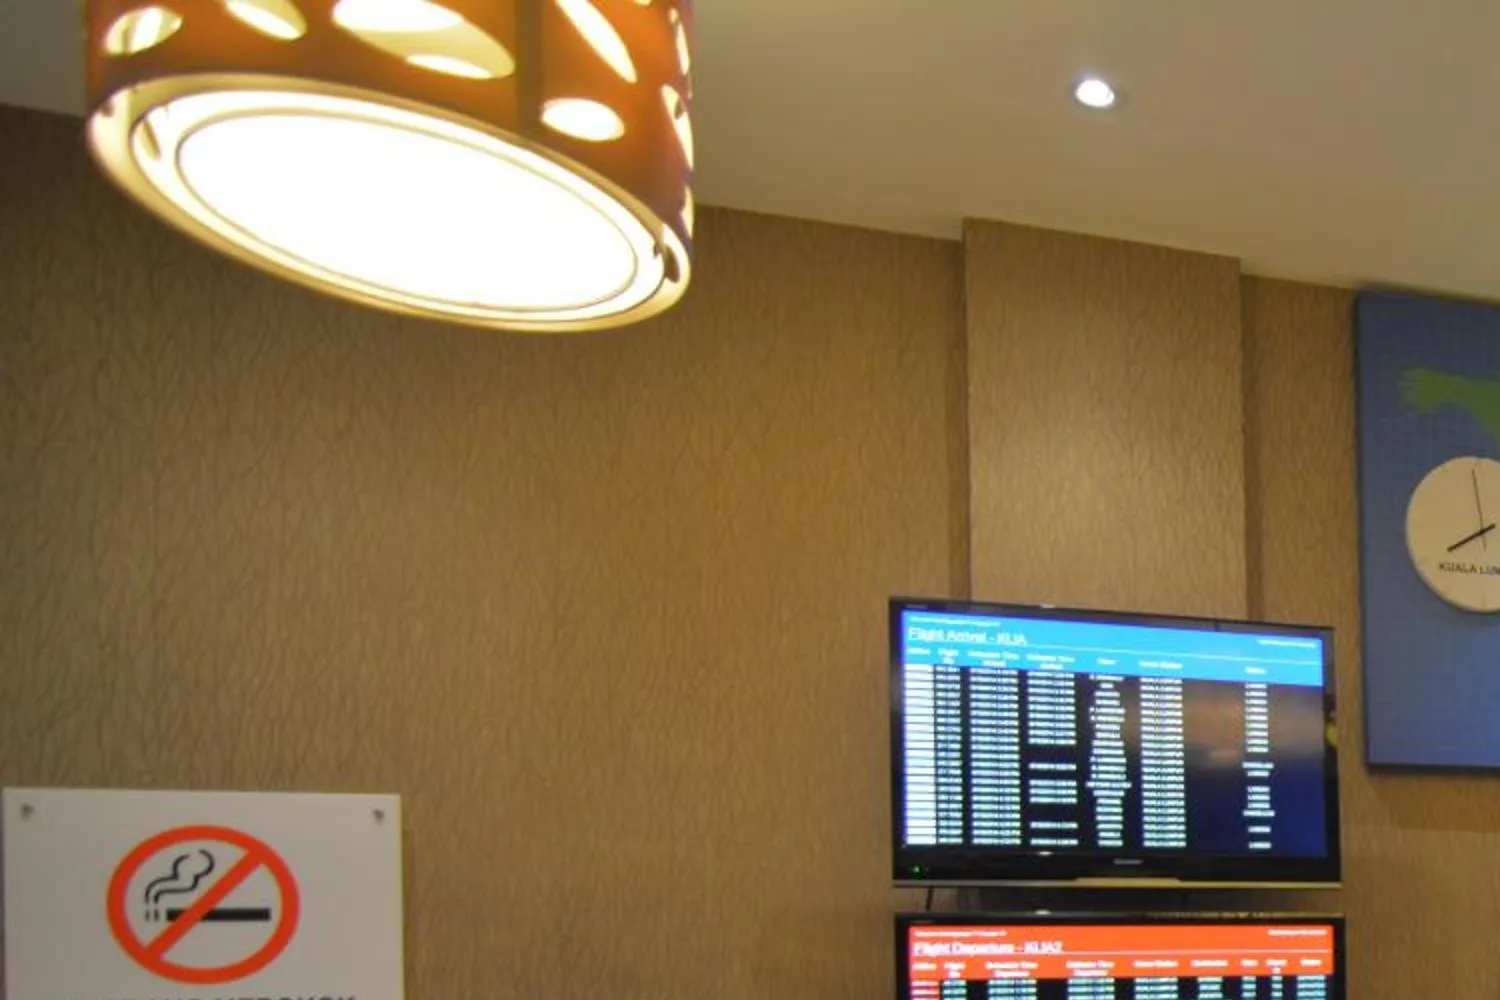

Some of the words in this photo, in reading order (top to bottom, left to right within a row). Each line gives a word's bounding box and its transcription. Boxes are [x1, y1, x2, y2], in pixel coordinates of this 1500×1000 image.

[1438, 562, 1477, 575] KUALA
[908, 627, 945, 643] Flight
[947, 630, 987, 644] Arrival
